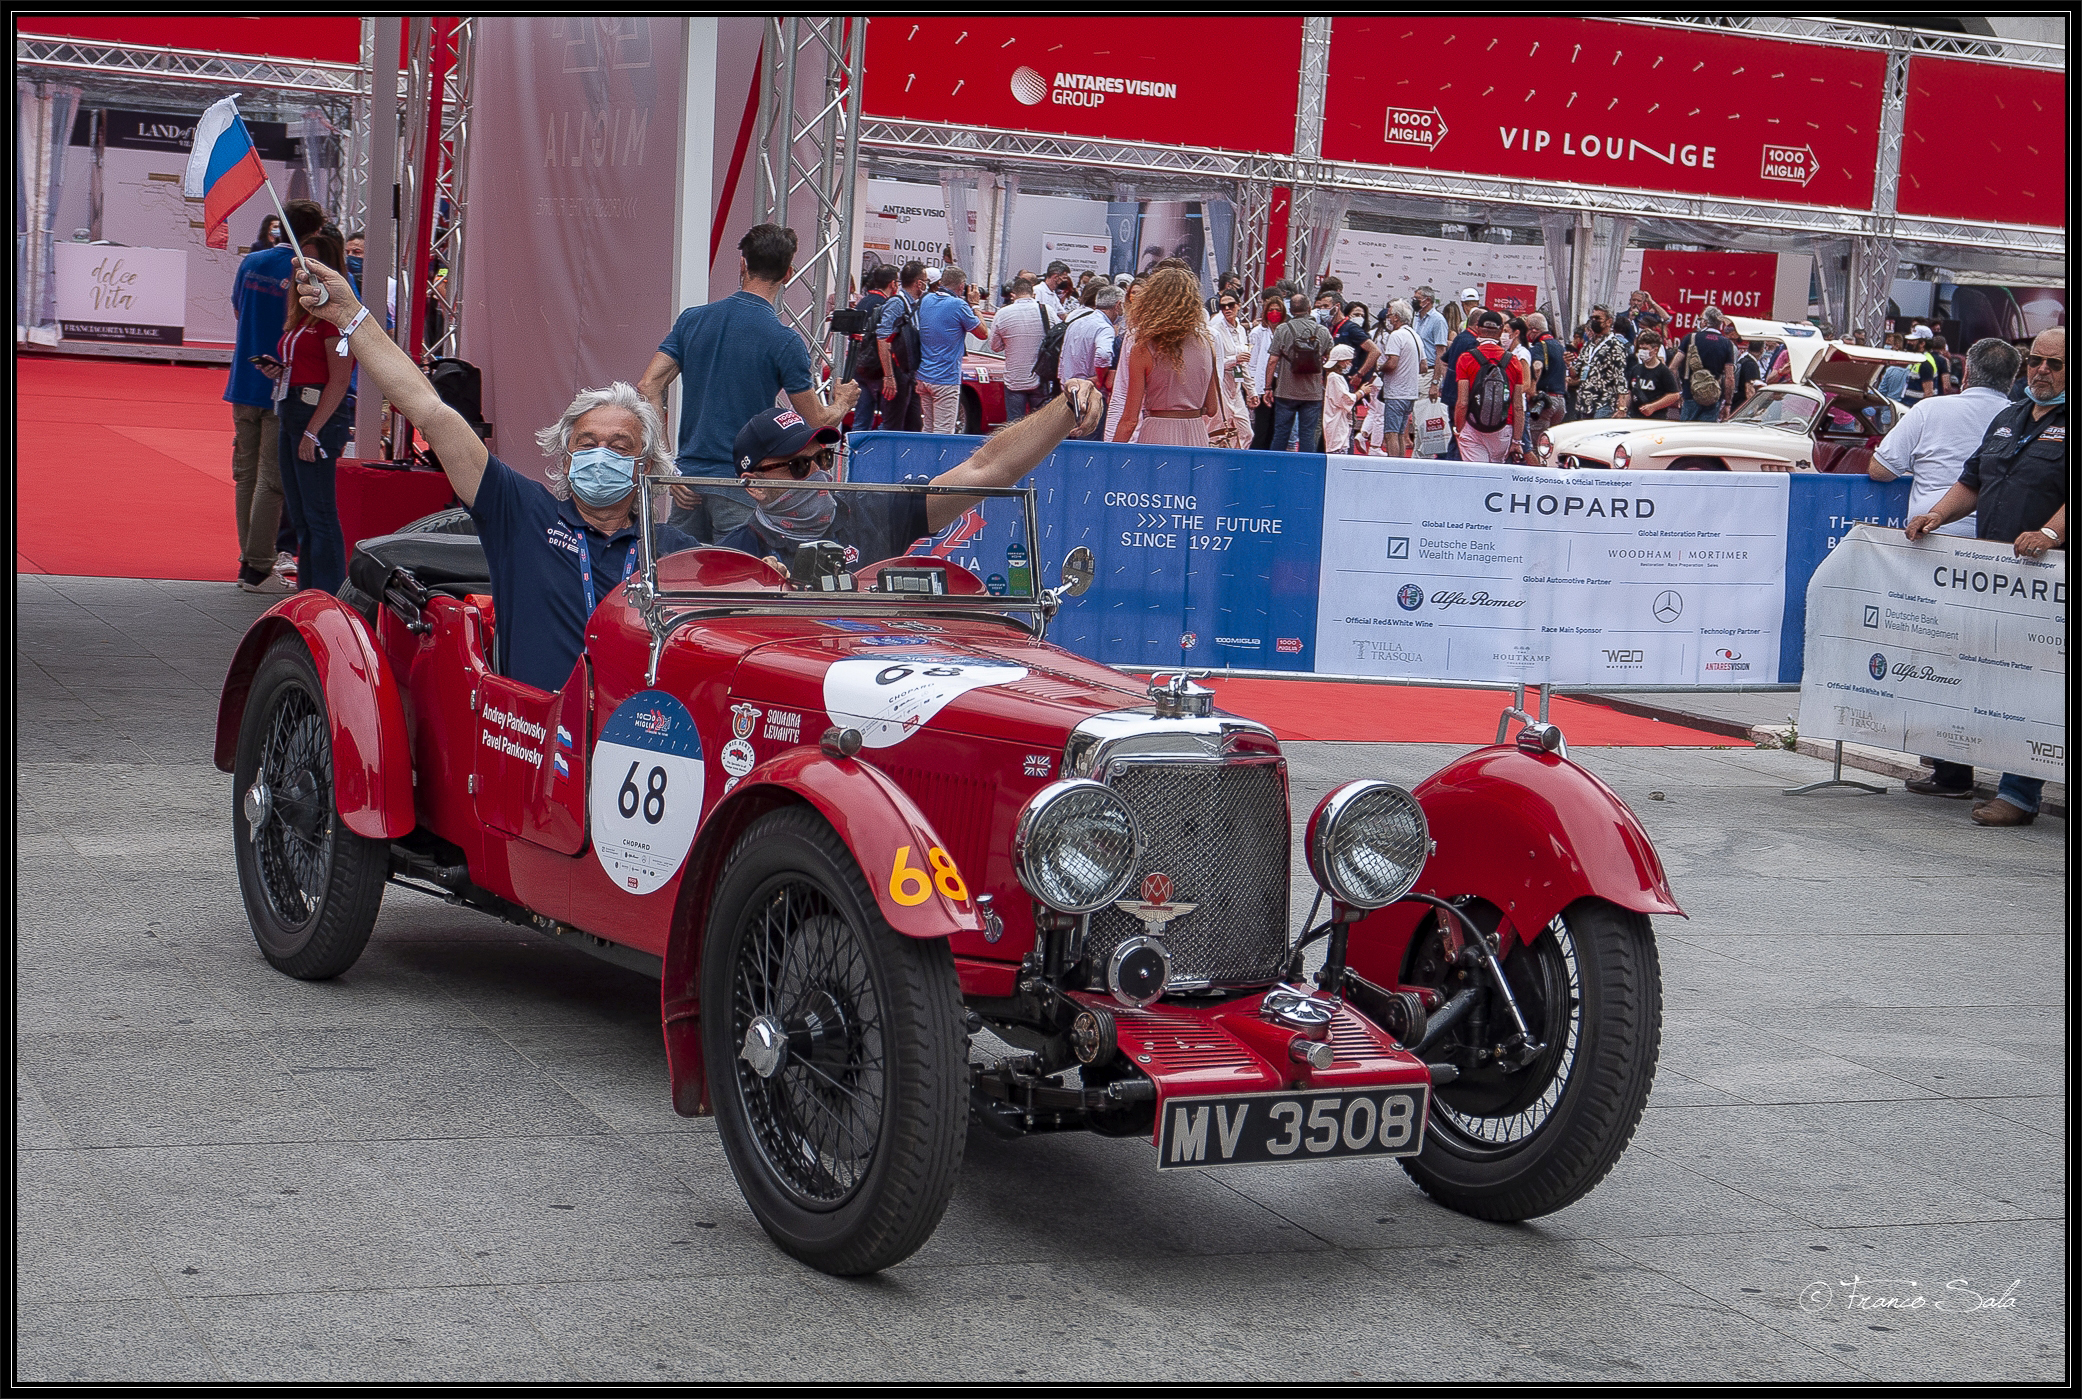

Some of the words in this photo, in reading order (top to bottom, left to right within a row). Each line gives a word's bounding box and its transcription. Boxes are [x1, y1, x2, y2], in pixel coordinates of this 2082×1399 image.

[1053, 72, 1124, 93] ANTARES
[1125, 79, 1177, 98] VISION
[1052, 89, 1105, 108] GROUP
[1392, 111, 1432, 128] 1000
[1388, 127, 1433, 143] MIGLIA
[1499, 125, 1551, 153] VIP
[1562, 132, 1717, 170] LOUNGE
[1769, 149, 1805, 165] 1000
[1765, 162, 1806, 180] MIGLIA
[882, 204, 921, 216] ANTARES
[923, 208, 945, 218] VISIO
[894, 239, 942, 253] NOLOGY
[1358, 240, 1387, 248] CHOPARD
[91, 257, 138, 286] dolce
[1457, 270, 1487, 278] CHOPARD
[89, 284, 138, 311] Vita
[1679, 288, 1717, 305] THE
[1721, 290, 1761, 308] MOST
[740, 456, 751, 469] 68
[1512, 475, 1533, 483] World
[1535, 476, 1564, 485] Sponsor
[1572, 478, 1594, 486] Official
[1594, 479, 1633, 488] Timekeeper
[1104, 492, 1197, 510] CROSSING
[1484, 491, 1655, 519] CHOPARD
[1216, 516, 1282, 534] FUTURE
[1422, 520, 1445, 529] Global
[1447, 522, 1464, 530] Lead
[1465, 523, 1493, 531] Partner
[1120, 531, 1177, 548] SINCE
[1189, 535, 1234, 551] 1927
[1659, 530, 1696, 538] Restoration
[548, 537, 579, 553] DRIVE
[1419, 537, 1468, 550] Deutsche
[1470, 540, 1496, 551] Bank
[1419, 550, 1454, 560] Wealth
[1456, 552, 1523, 564] Management
[1607, 549, 1672, 559] WOODHAM
[1688, 550, 1748, 560] MORTIMER
[1954, 550, 1971, 559] World
[1971, 551, 1995, 562] Sponsor
[2000, 556, 2022, 565] Official
[2022, 558, 2057, 569] Timekeeper
[1522, 575, 1545, 584] Global
[1546, 576, 1585, 585] Automotive
[1586, 578, 1612, 586] Partner
[1430, 591, 1470, 610] Alfa
[1470, 591, 1527, 608] Romeo
[1345, 617, 1372, 625] Official
[1373, 618, 1413, 627] Red&White
[1414, 620, 1433, 628] Wine
[1885, 608, 1920, 622] Deutsche
[1920, 613, 1939, 626] Bank
[1541, 625, 1557, 633] Race
[1575, 627, 1602, 635] Sponsor
[1700, 627, 1736, 636] Technology
[1884, 620, 1910, 633] Wealth
[1910, 624, 1959, 641] Management
[1371, 641, 1402, 652] VILLA
[2027, 633, 2065, 647] WOOD
[1371, 651, 1423, 663] TRASQUA
[1493, 653, 1551, 662] HOUTKAMP
[1958, 653, 1977, 662] Global
[1977, 656, 2010, 668] Automotive
[2010, 661, 2033, 671] Partner
[875, 664, 964, 686] 68
[1891, 662, 1918, 682] Alfa
[1919, 666, 1962, 685] Romeo
[888, 683, 935, 703] CHOPARD
[1826, 681, 1851, 691] Official
[1851, 708, 1873, 720] VILLA
[1973, 706, 1988, 716] Race
[1988, 709, 2001, 718] Main
[2002, 712, 2026, 723] Sponsor
[482, 702, 507, 730] Andrey
[506, 712, 547, 745] Pankovsky
[1850, 718, 1887, 734] TRASQUA
[763, 724, 800, 744] LEVANTE
[482, 728, 502, 751] Pavel
[501, 736, 543, 770] Pankovsky
[617, 760, 668, 826] 68
[622, 839, 650, 851] CHOPARD
[889, 845, 968, 906] 68
[1171, 1104, 1250, 1163] MV
[1266, 1094, 1414, 1156] 3508
